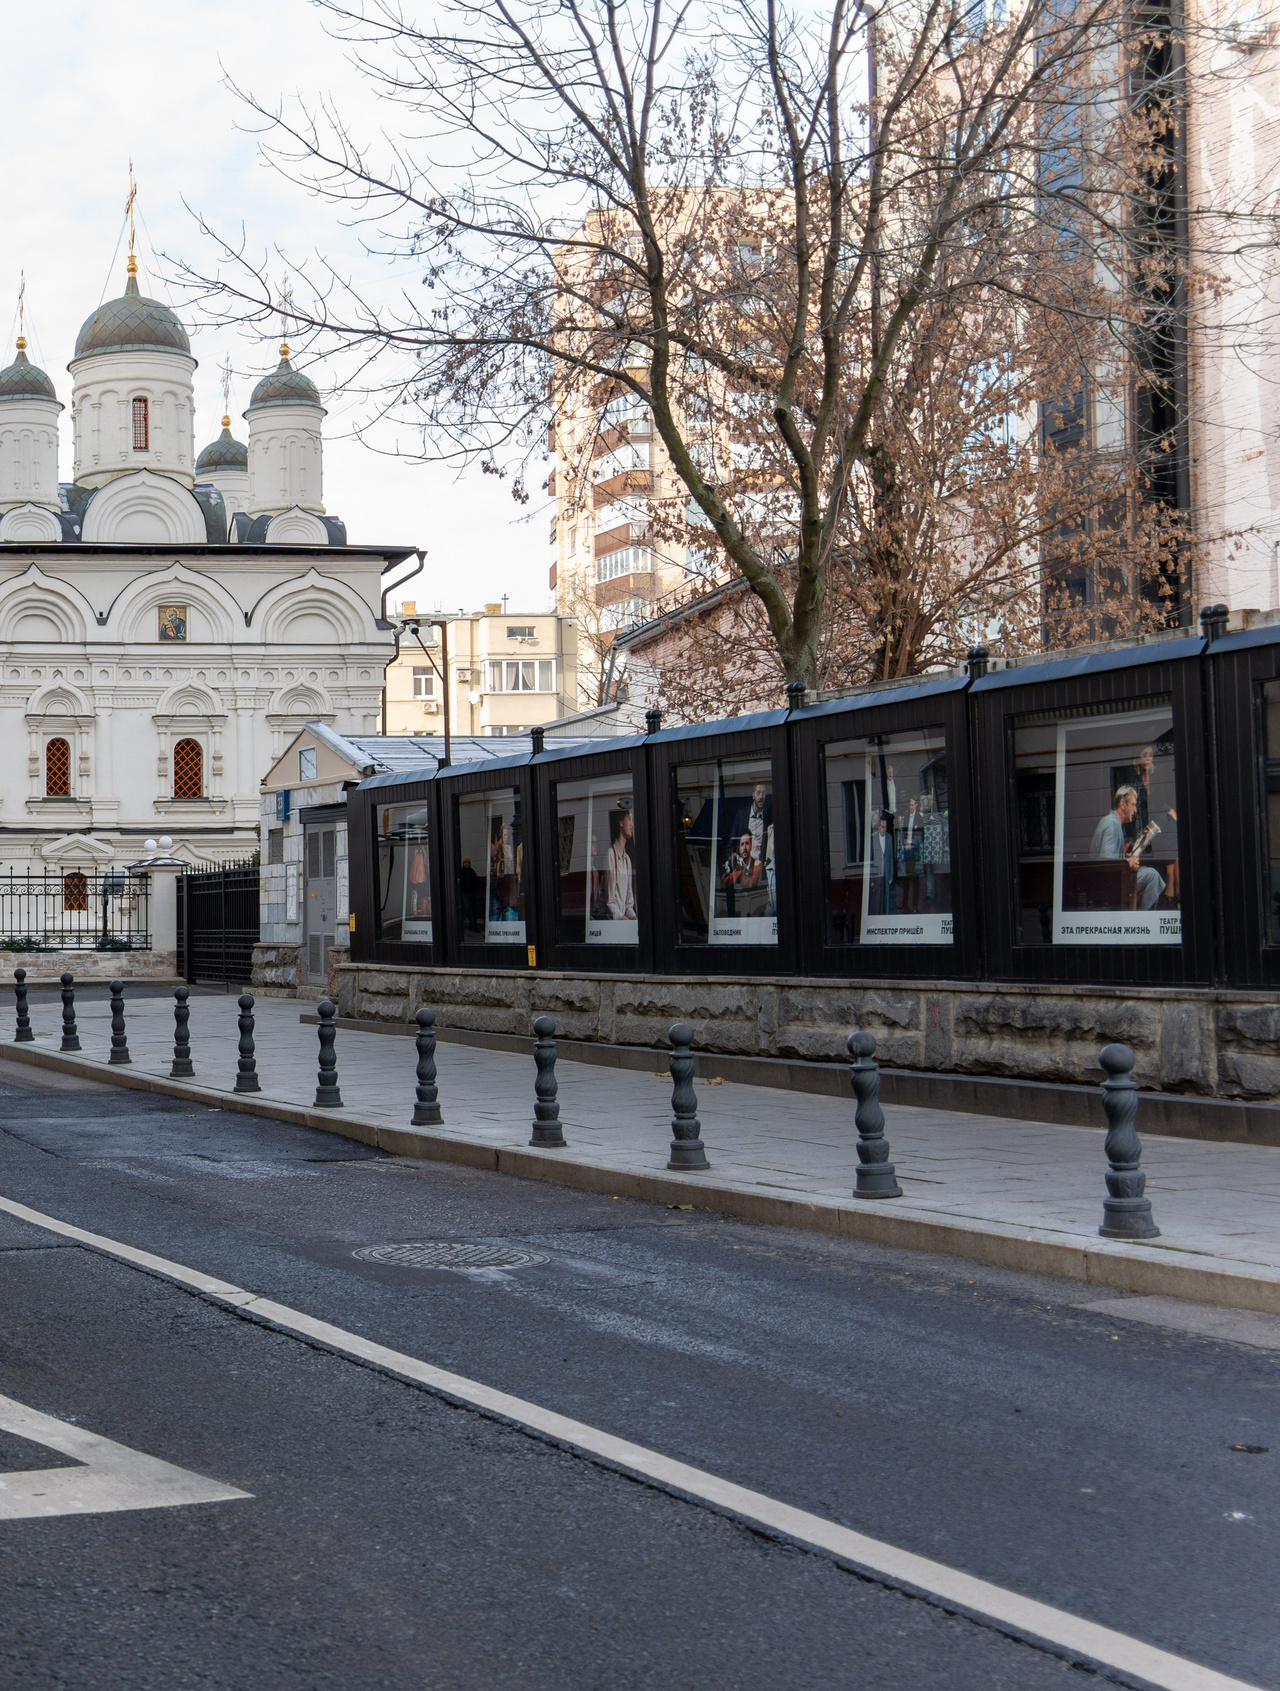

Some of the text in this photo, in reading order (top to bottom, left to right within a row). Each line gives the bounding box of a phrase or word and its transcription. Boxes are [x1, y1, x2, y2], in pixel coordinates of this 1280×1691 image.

[588, 929, 602, 937] ЛИЦЕЙ
[713, 929, 742, 937] ЗАПОВЕДНИК
[866, 925, 924, 935] ИНСПЕКТОР ПРИШЁЛ
[1061, 926, 1151, 935] ЭТА ПРЕКРАСНАЯ ЖИЗНЬ
